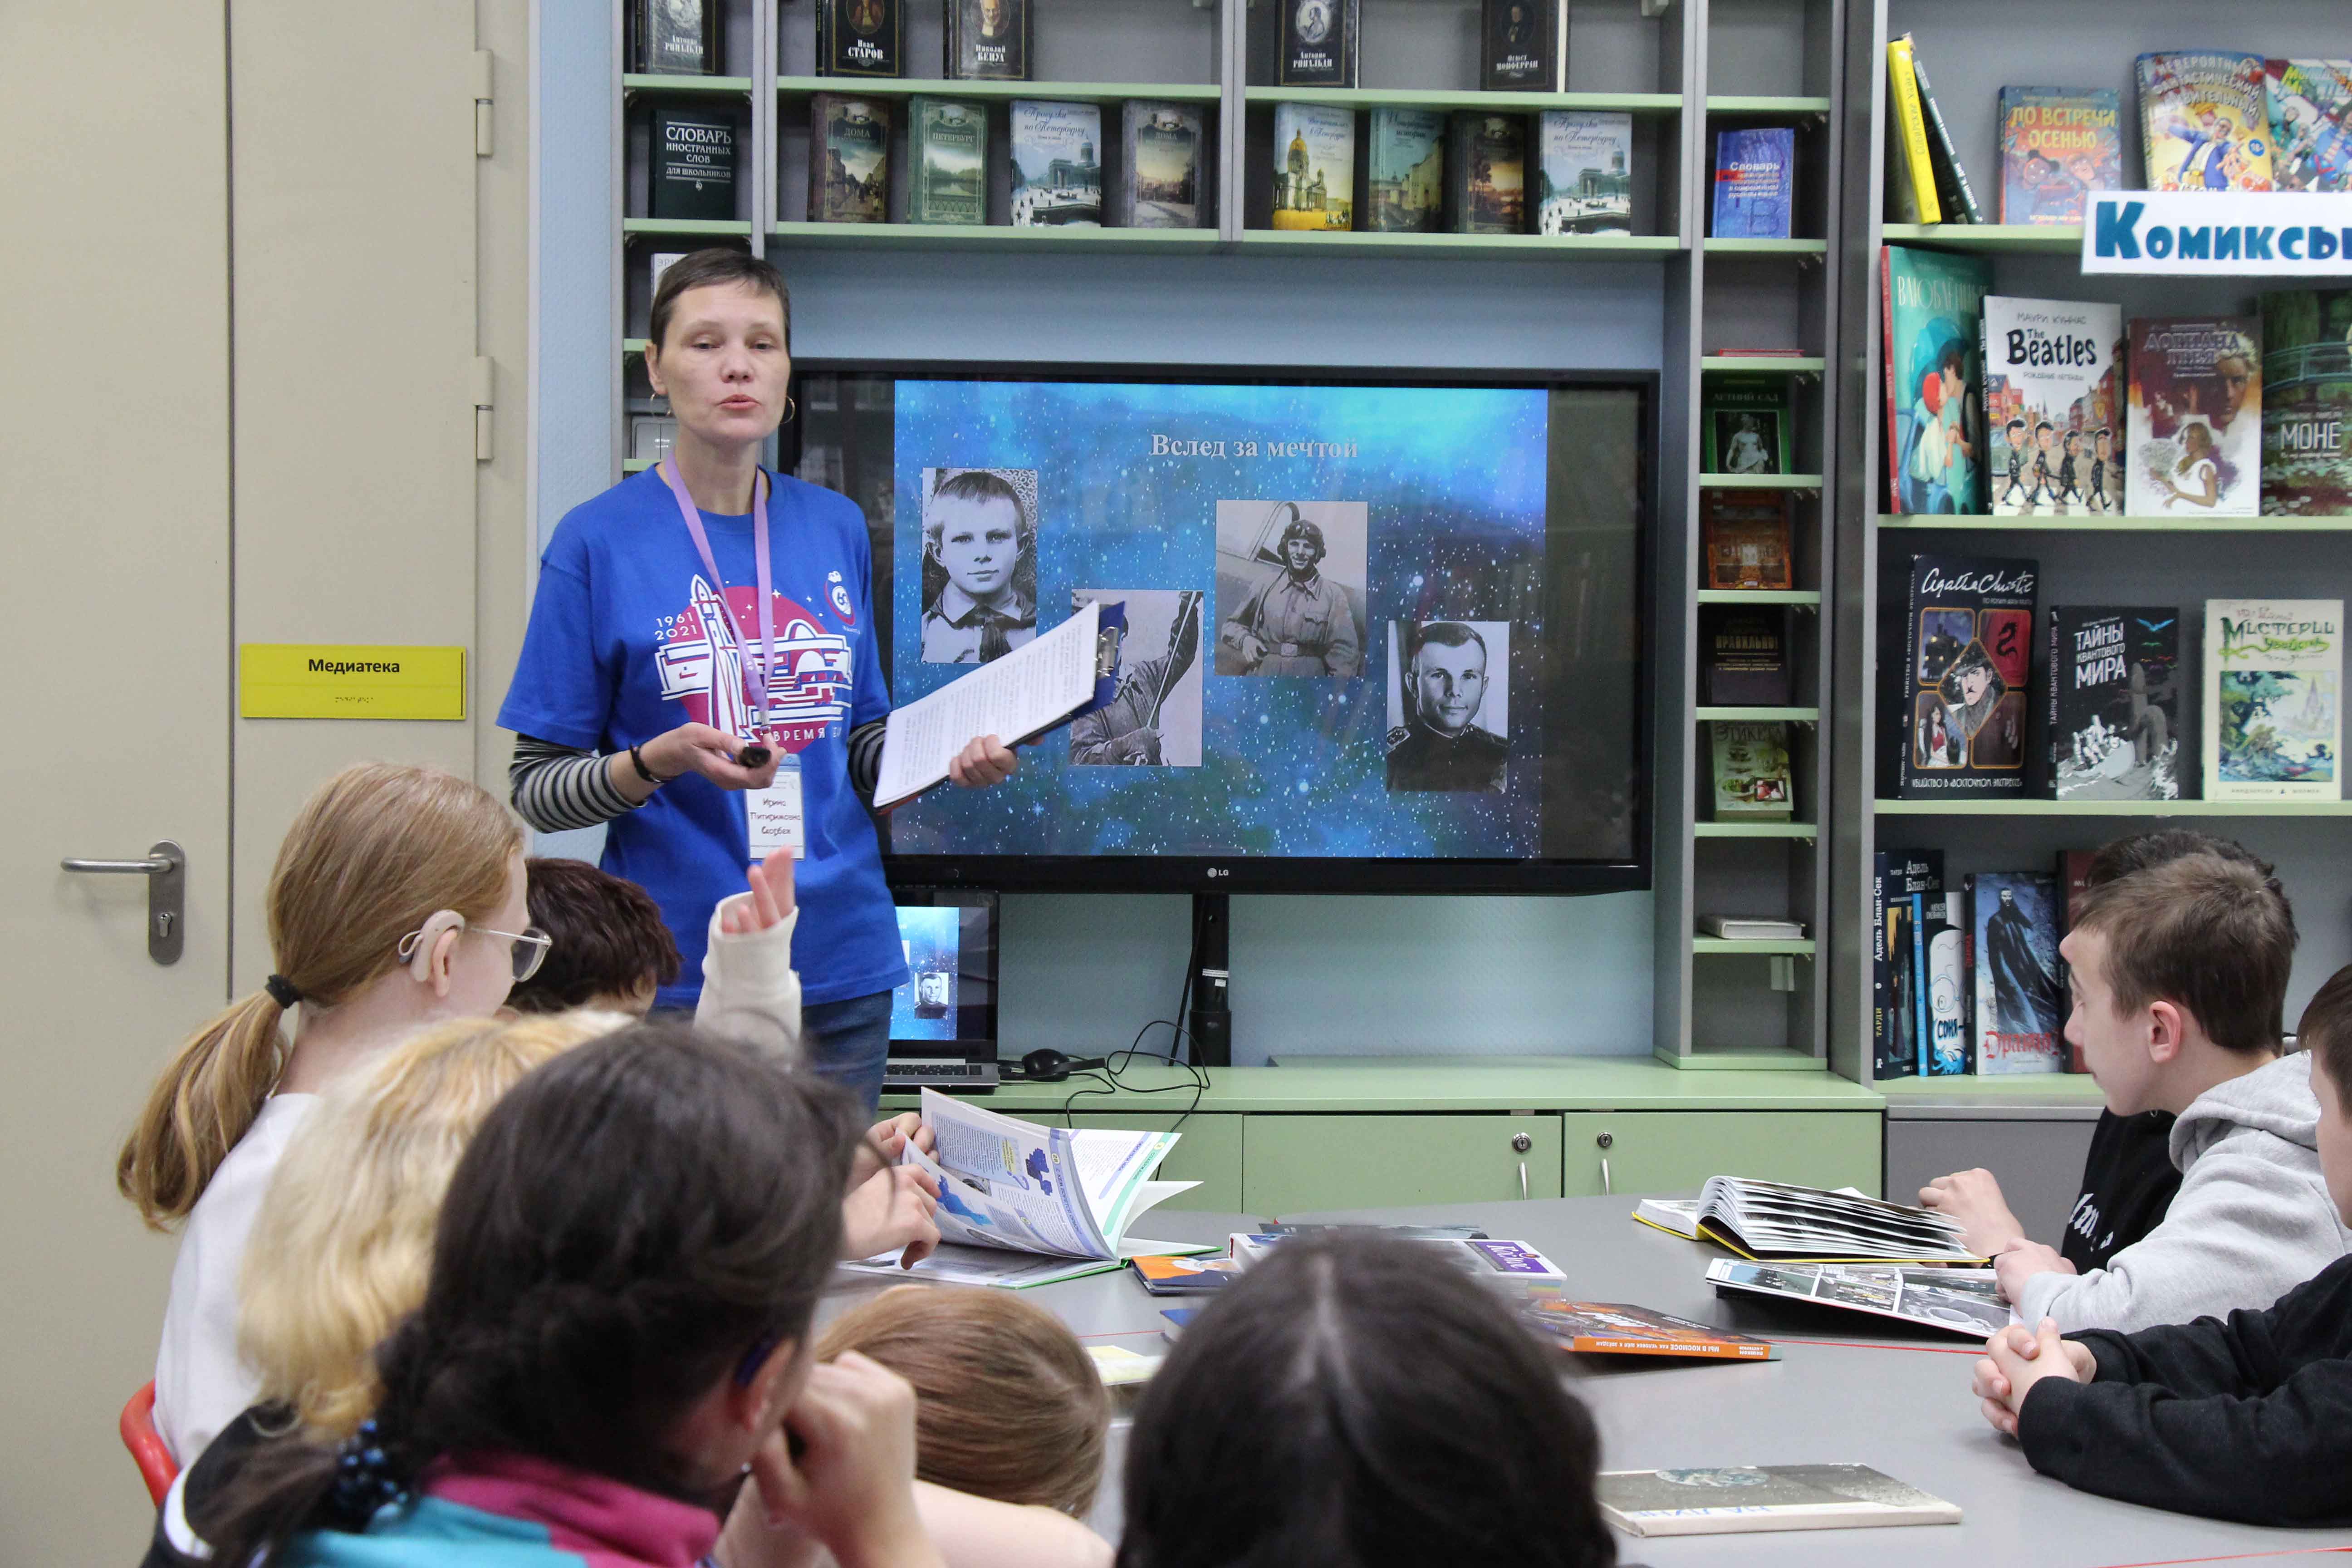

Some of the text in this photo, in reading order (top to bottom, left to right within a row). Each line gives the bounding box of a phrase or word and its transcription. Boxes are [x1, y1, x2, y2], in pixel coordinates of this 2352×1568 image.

[858, 39, 874, 49] Иван
[848, 47, 884, 59] СТАРОВ
[977, 52, 1005, 63] БЕНУА
[2009, 106, 2116, 127] ДО ВСТРЕЧИ
[666, 127, 732, 144] СЛОВАРЬ
[932, 132, 975, 143] ПЕТЕРБУРГ
[2029, 129, 2097, 149] ОСЕНЬЮ
[666, 142, 730, 155] ИНОСТРАННЫХ
[686, 154, 710, 163] СЛОВ
[666, 167, 731, 178] ДЛЯ ШКОЛЬНИКОВ
[1730, 162, 1780, 172] Словарь
[2095, 201, 2352, 260] Комиксы
[2027, 328, 2045, 339] The
[2006, 328, 2097, 367] Beatles
[2280, 421, 2342, 451] МОНЕ
[1150, 433, 1358, 459] Вслед за мечтой
[1921, 568, 2034, 598] Agatha Christie
[656, 612, 693, 627] 1961
[654, 625, 697, 641] 2021
[2073, 622, 2124, 651] ТАЙНЫ
[2076, 642, 2126, 664] КВАНТОВОГО
[308, 658, 400, 675] Медиатека
[2075, 654, 2127, 690] МИРА
[773, 727, 826, 742] ВРЕМЯ
[1906, 860, 1929, 875] Адель
[1874, 929, 1883, 961] Адель
